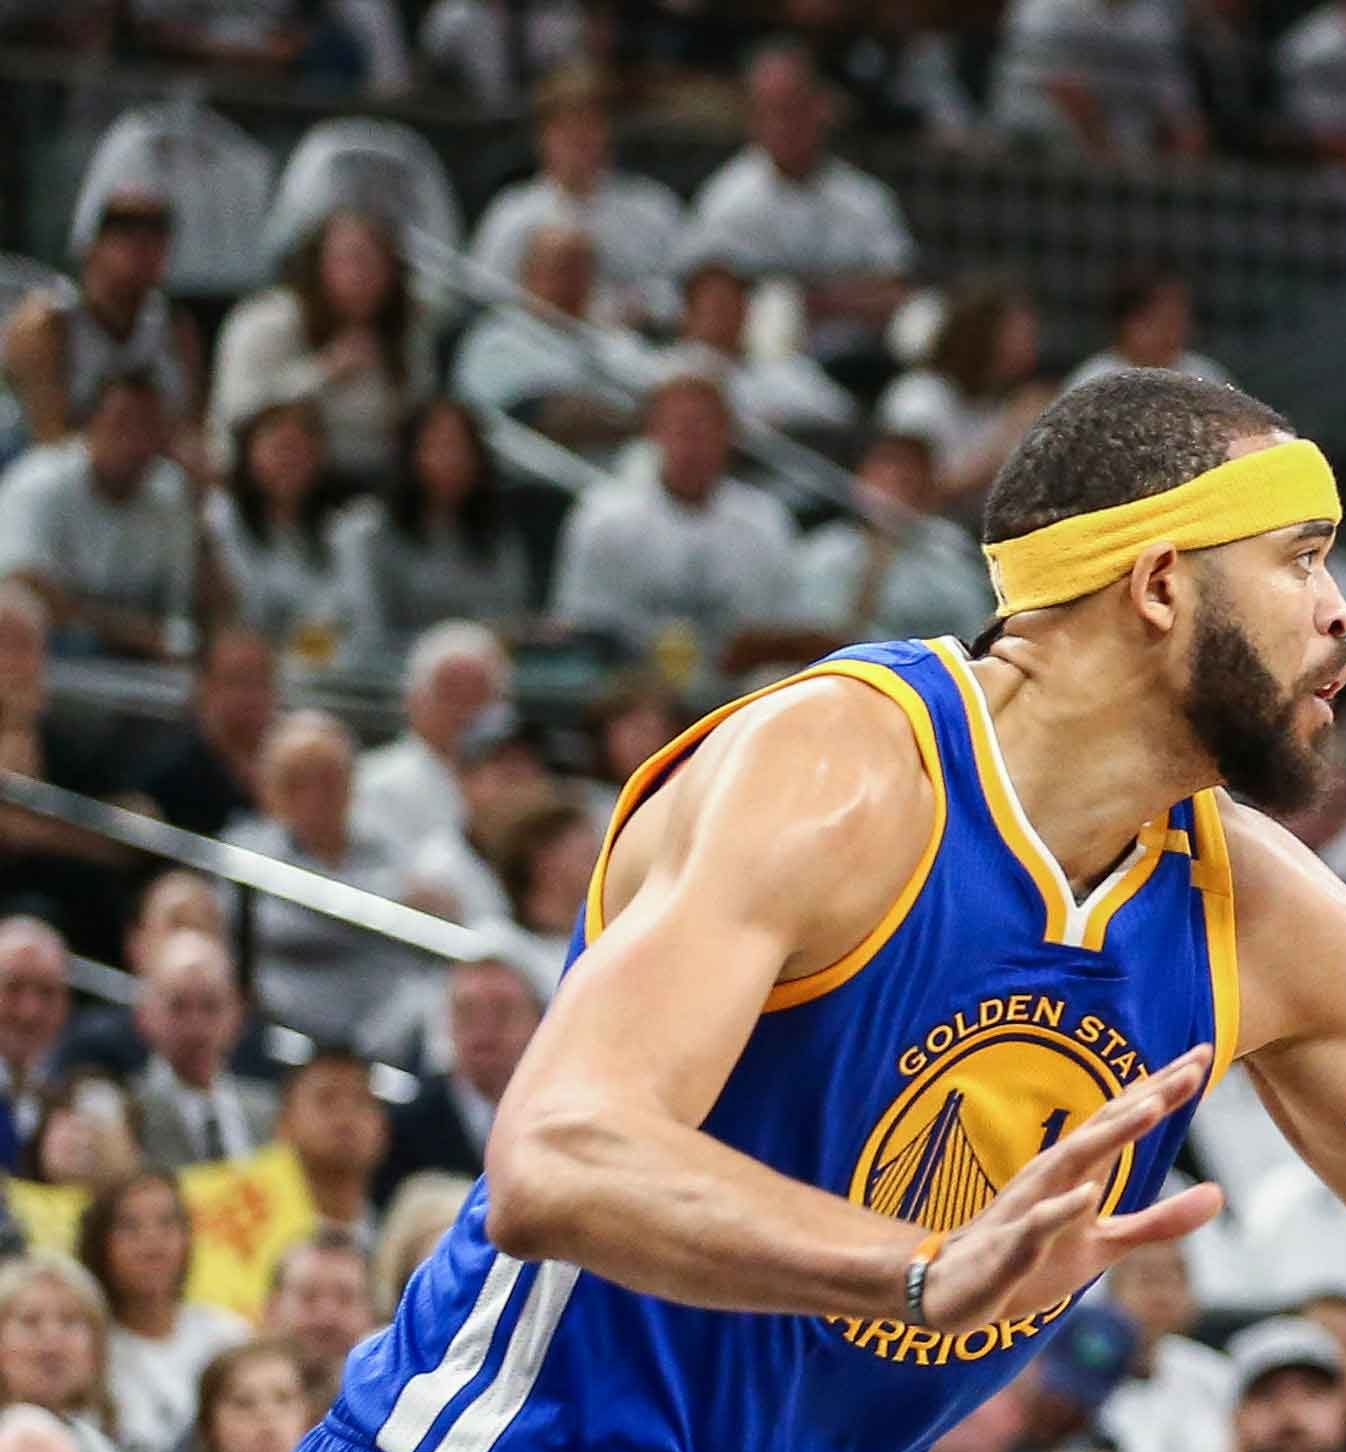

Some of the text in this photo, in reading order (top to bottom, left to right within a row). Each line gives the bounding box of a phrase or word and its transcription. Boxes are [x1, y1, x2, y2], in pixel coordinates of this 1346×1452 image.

[899, 994, 1151, 1084] GOLDEN STA
[823, 1293, 1073, 1366] ARRIOR
